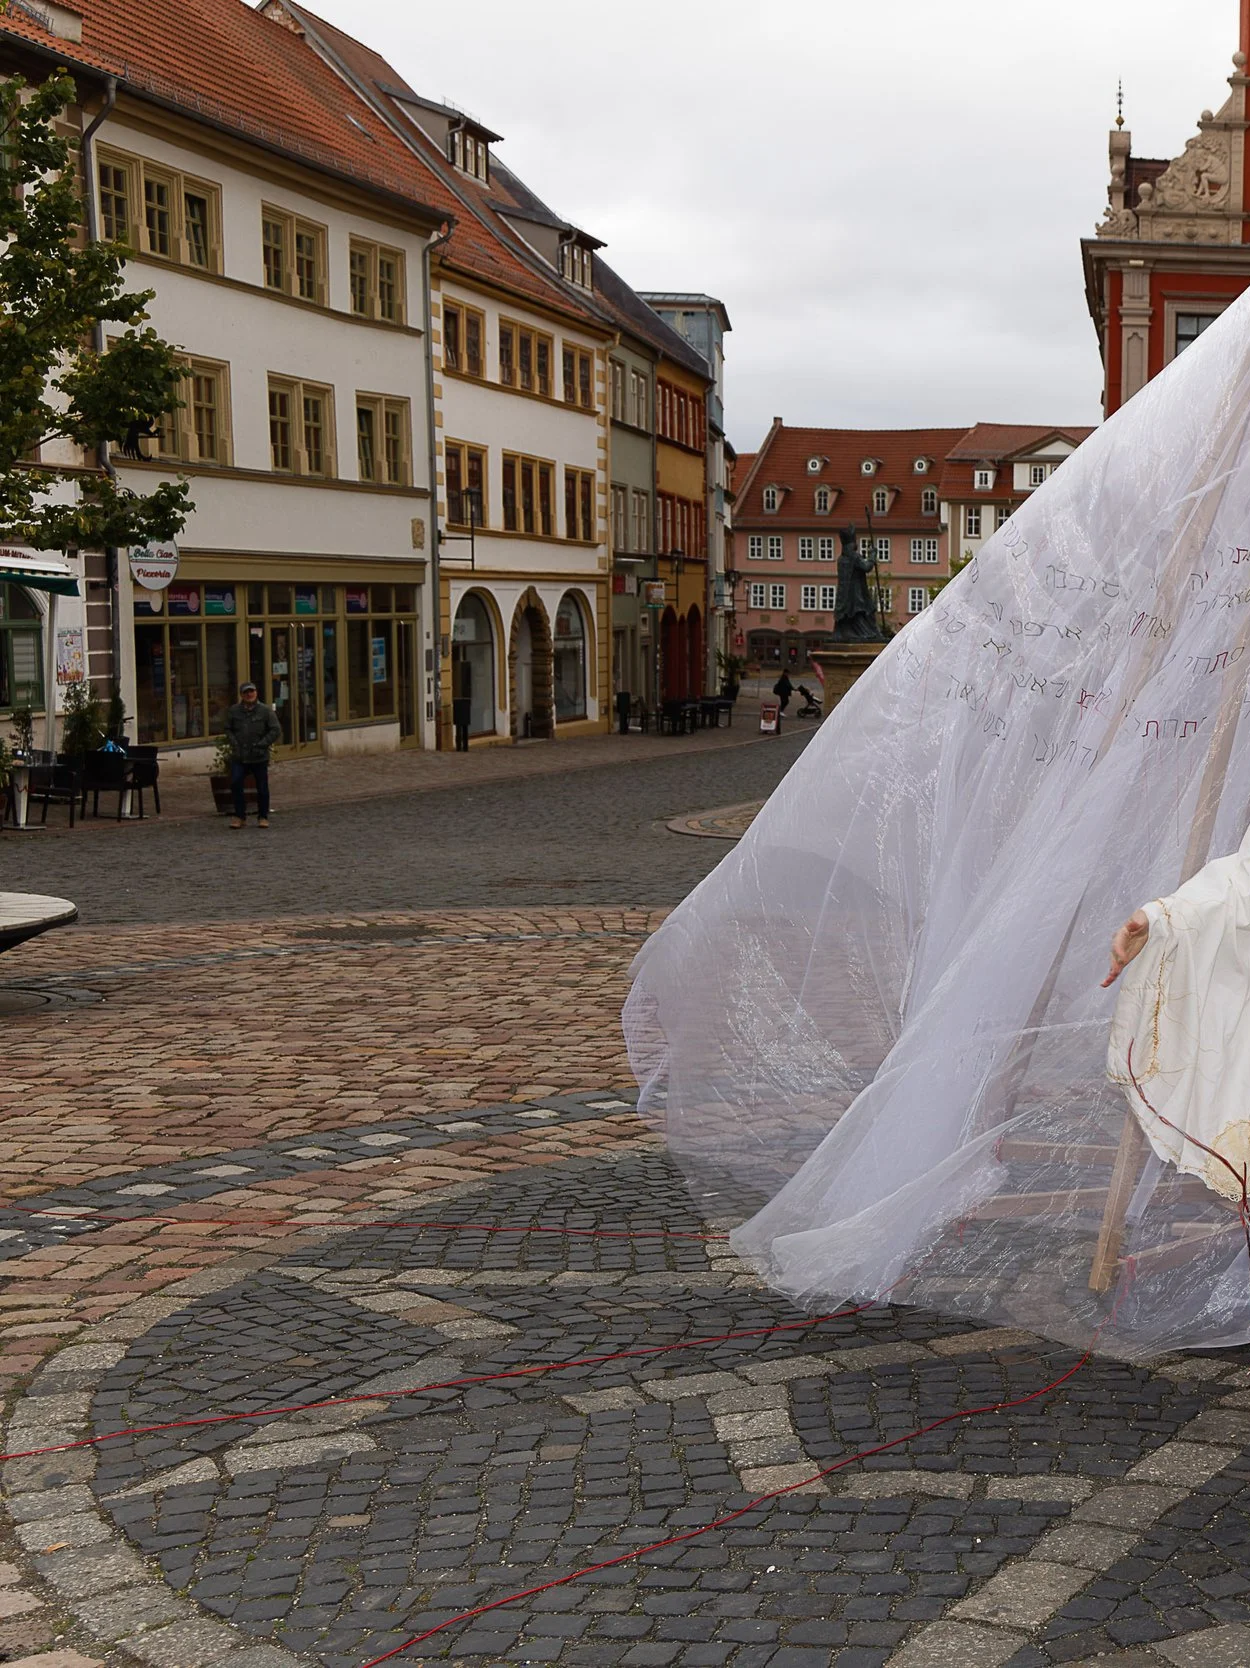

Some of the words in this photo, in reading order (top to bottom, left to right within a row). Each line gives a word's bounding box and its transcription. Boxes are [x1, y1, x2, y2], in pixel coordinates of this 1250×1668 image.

[133, 548, 155, 558] Bella
[156, 549, 174, 559] Ciao
[136, 567, 171, 578] Pizzeria
